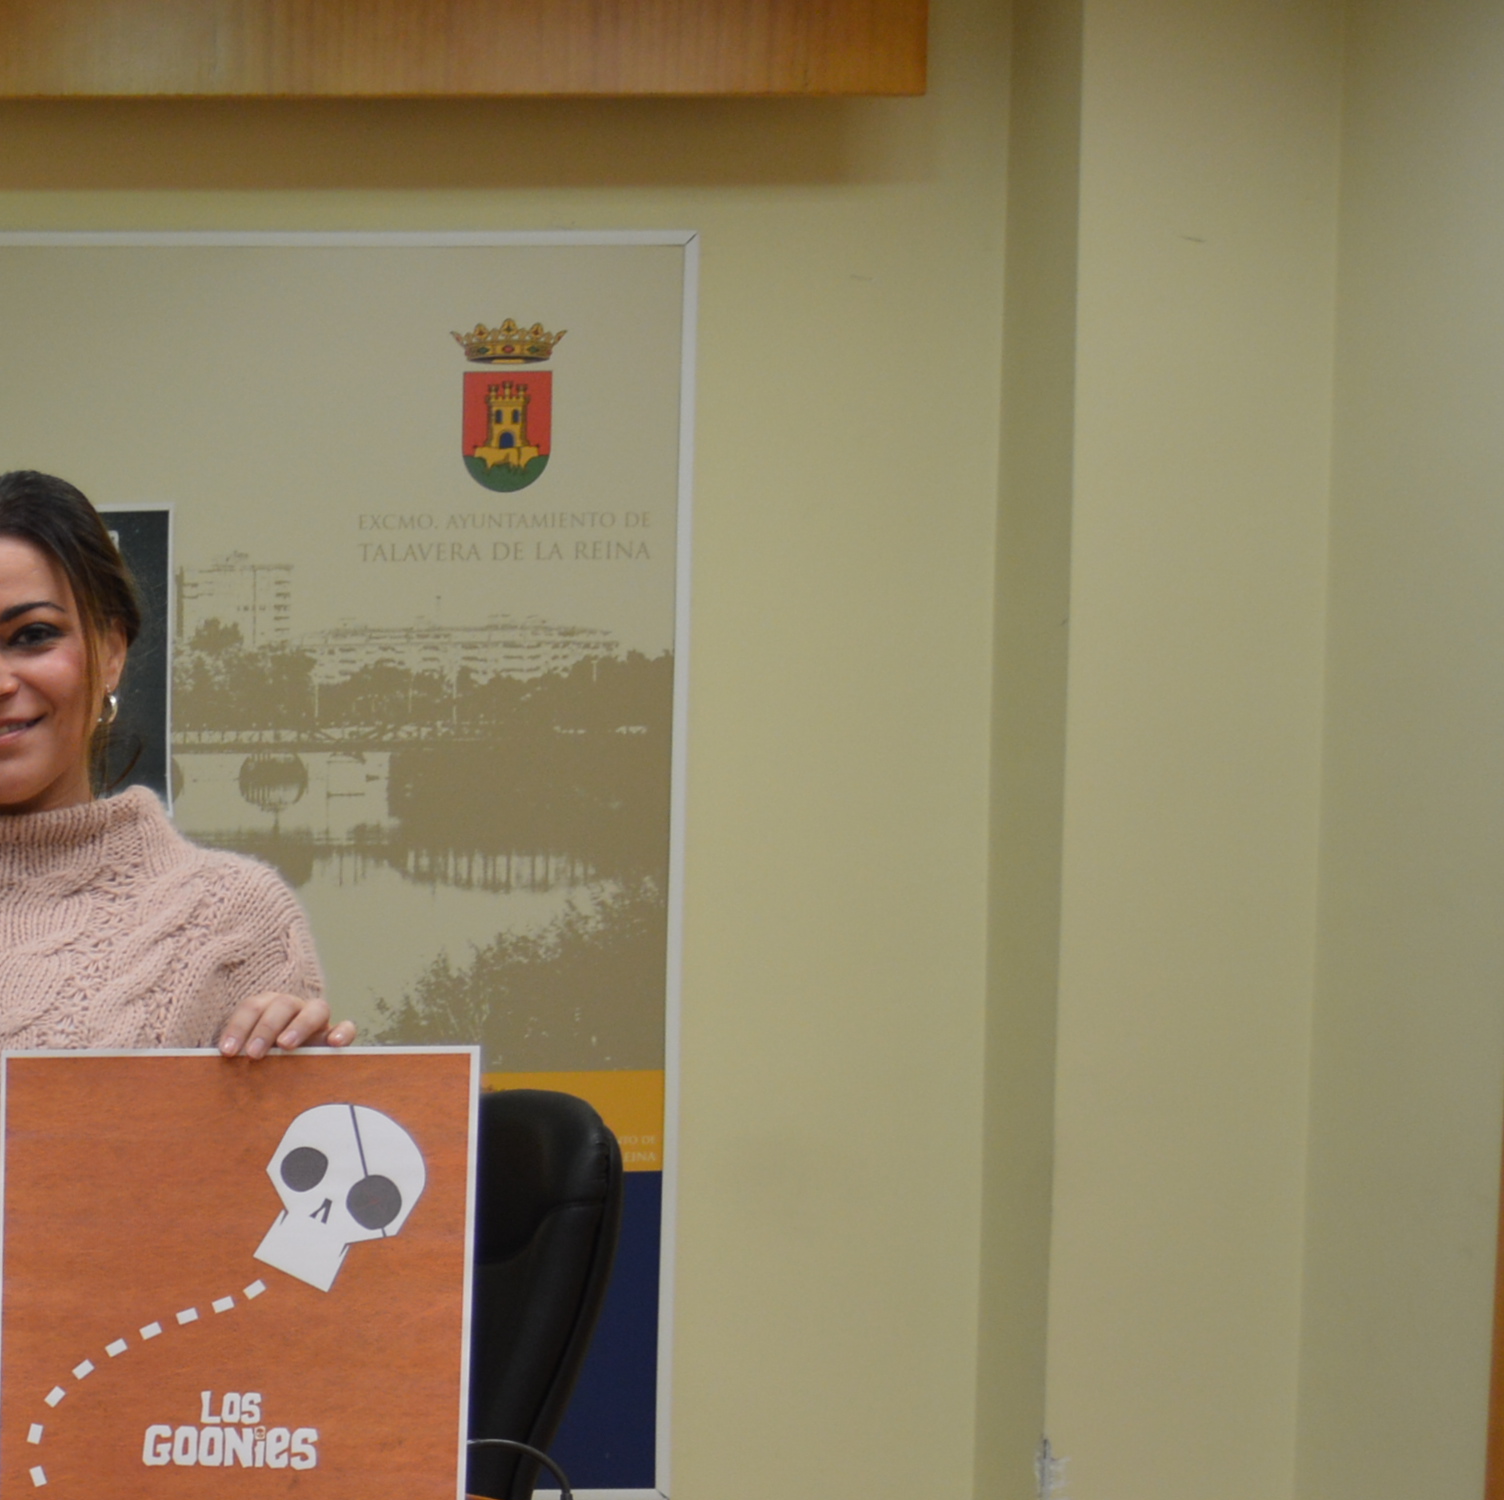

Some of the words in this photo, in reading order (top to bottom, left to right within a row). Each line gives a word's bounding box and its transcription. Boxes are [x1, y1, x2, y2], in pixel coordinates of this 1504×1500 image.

[358, 513, 438, 531] EXCMO.
[446, 511, 616, 529] AYUNTAMIENTO
[624, 511, 651, 528] DE
[358, 542, 482, 562] TALAVERA
[492, 541, 524, 561] DE
[536, 541, 564, 561] LA
[575, 540, 651, 560] REINA
[200, 1390, 263, 1425] LOS
